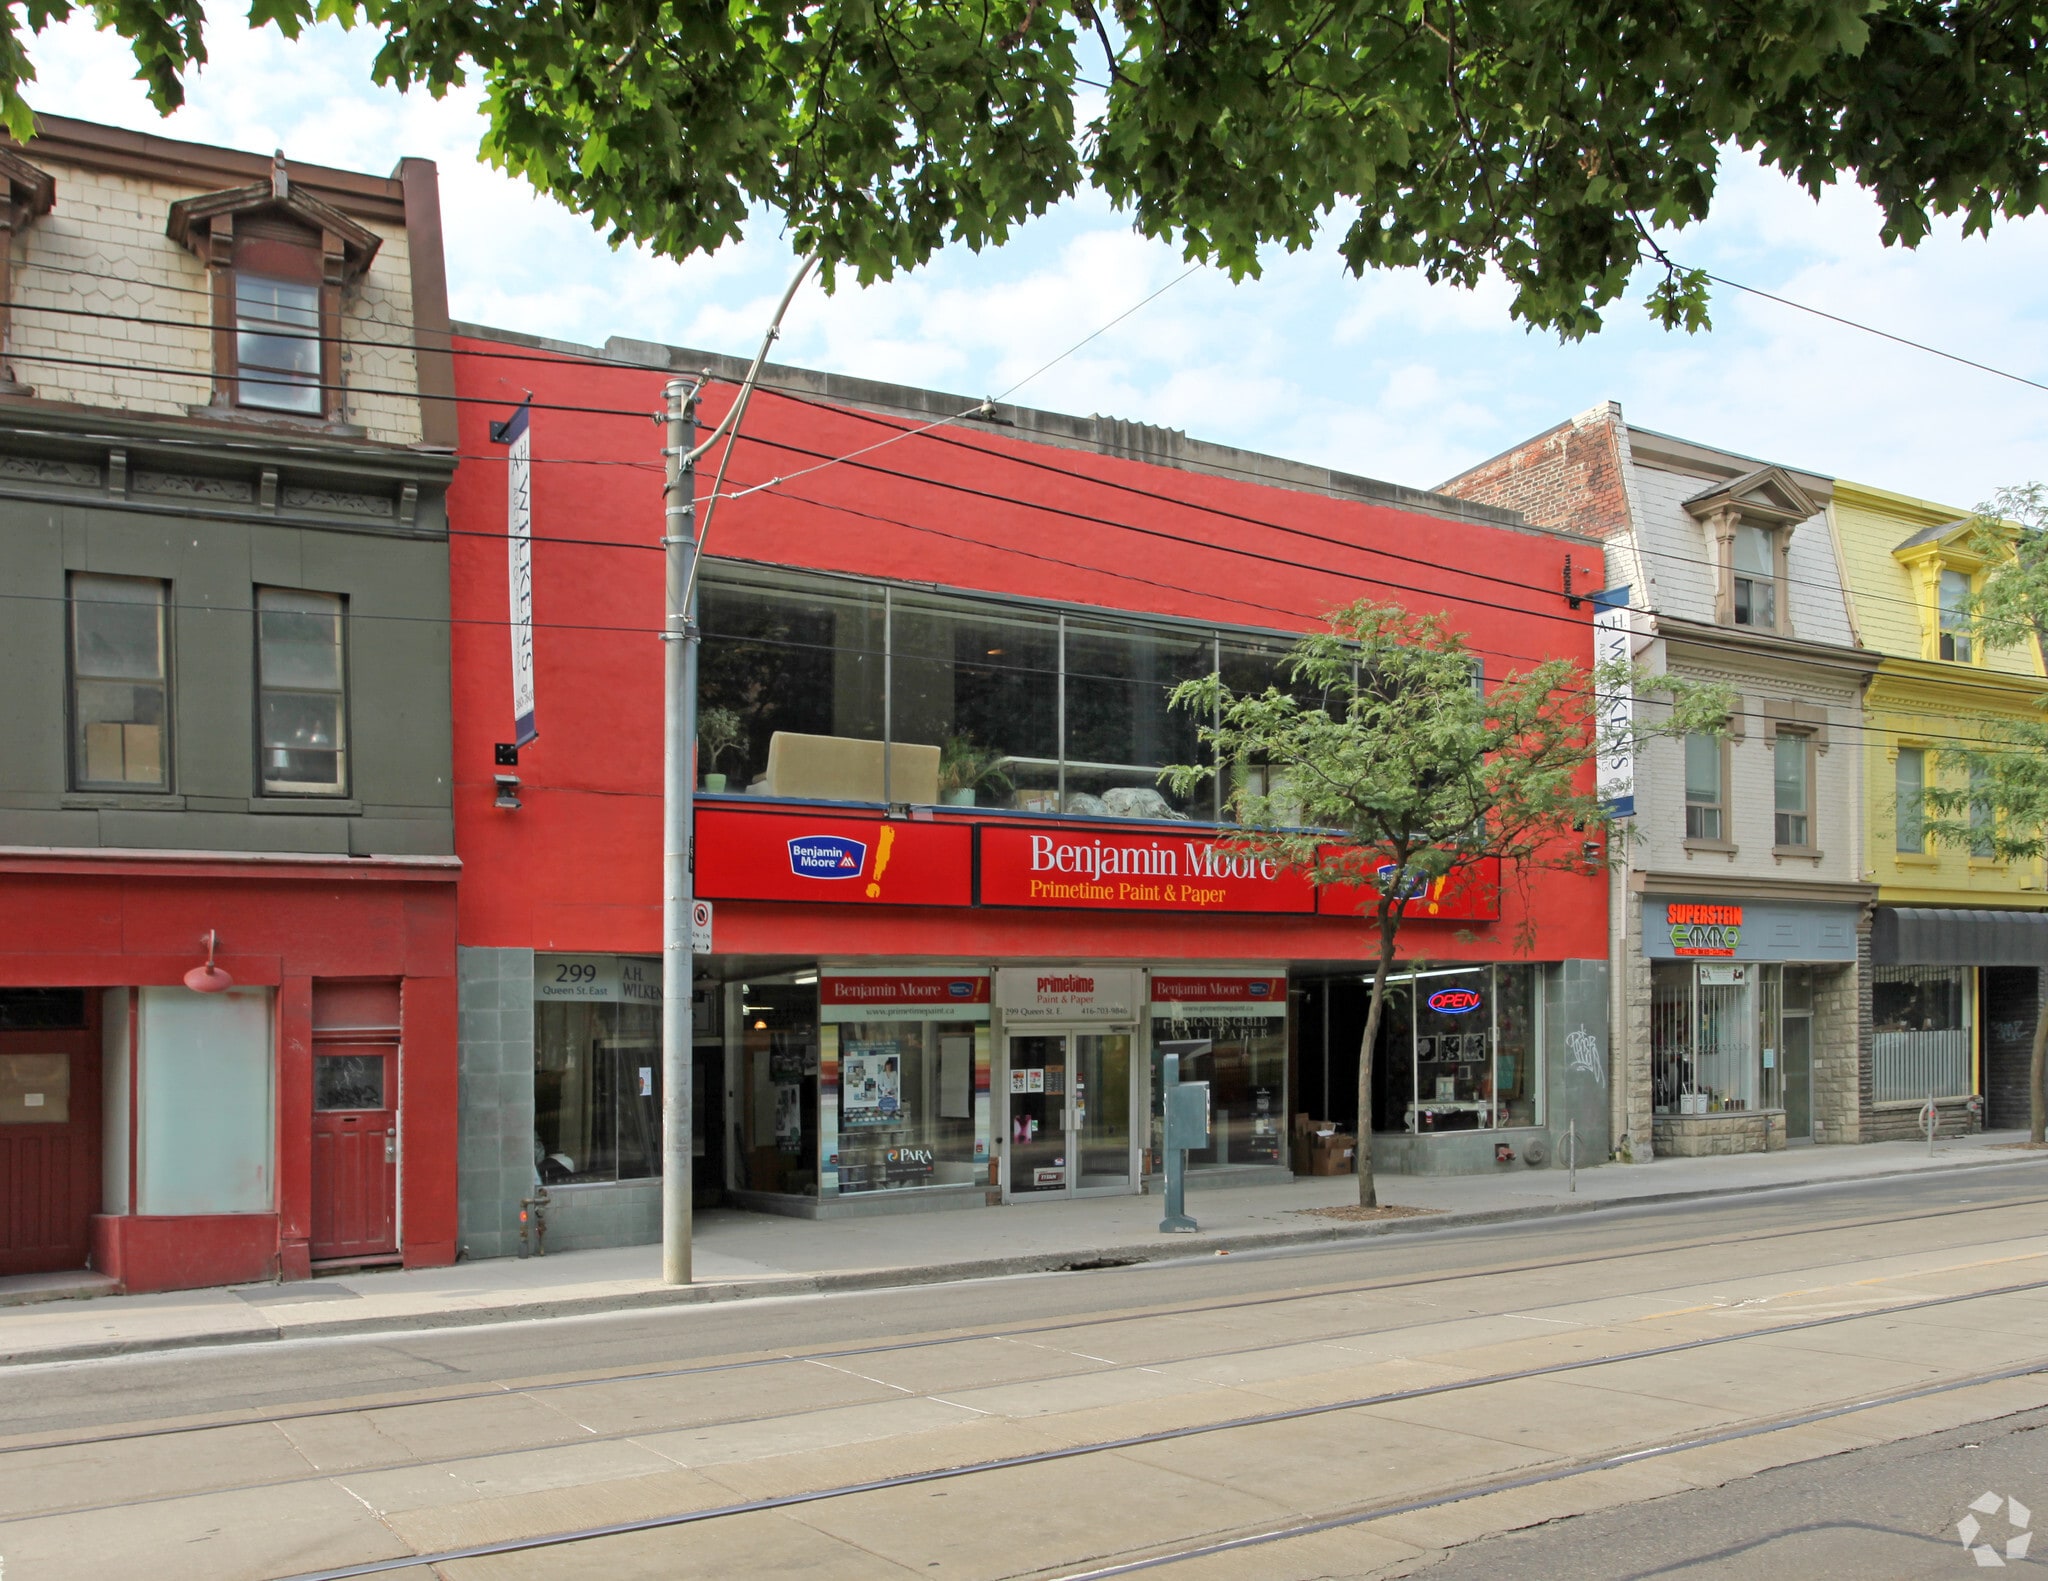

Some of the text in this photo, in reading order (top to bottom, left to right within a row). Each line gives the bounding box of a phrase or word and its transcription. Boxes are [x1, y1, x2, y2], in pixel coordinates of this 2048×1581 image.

[519, 473, 532, 672] WILKENS
[1609, 636, 1629, 770] WKENS
[793, 845, 843, 859] Benjamin
[1029, 835, 1177, 881] Benjamin
[801, 857, 835, 868] Moore
[1030, 879, 1226, 906] Primetime Paint & Paper
[555, 964, 597, 983] 299
[623, 966, 644, 982] A.H.
[542, 985, 608, 996] Queen St. East
[834, 983, 896, 999] Benjamin
[901, 983, 941, 997] Moore
[1157, 982, 1207, 997] Benjamin
[1210, 982, 1243, 995] Moore
[1037, 994, 1094, 1006] Paint & Paper
[1430, 993, 1479, 1008] OPEN
[866, 1007, 955, 1017] www.primetimepaint.ca
[1005, 1007, 1019, 1016] 299
[1020, 1007, 1045, 1017] Queen
[1233, 1016, 1268, 1027] GUILD
[900, 1148, 933, 1164] PARA
